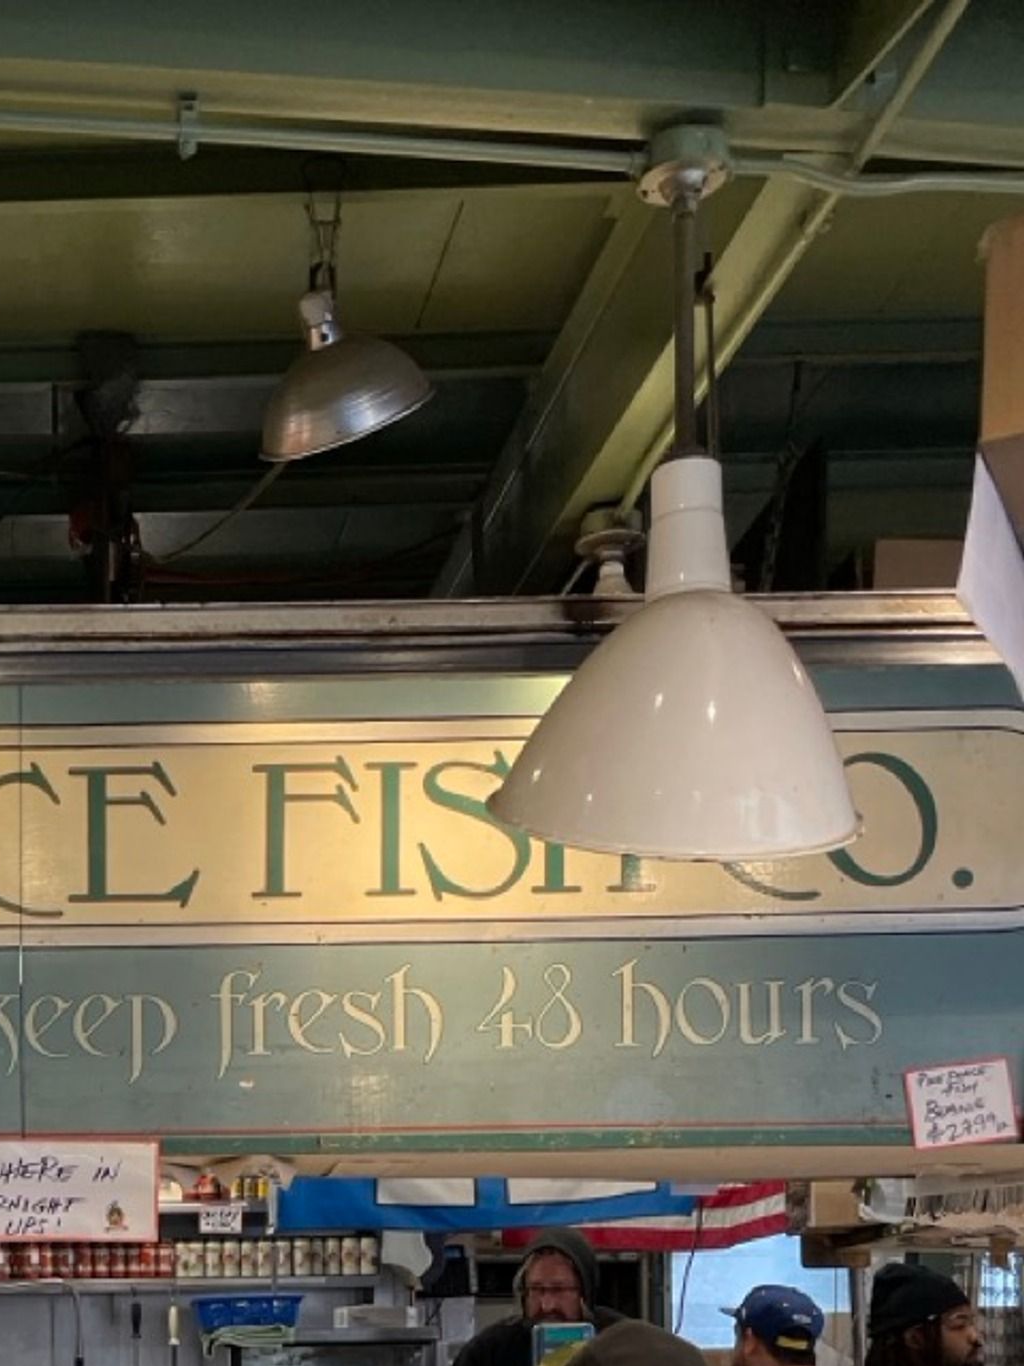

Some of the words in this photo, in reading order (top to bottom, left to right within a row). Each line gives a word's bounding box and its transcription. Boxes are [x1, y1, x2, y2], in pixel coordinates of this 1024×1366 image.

[209, 960, 445, 1080] fresh
[476, 963, 583, 1050] 48
[611, 957, 884, 1059] hours
